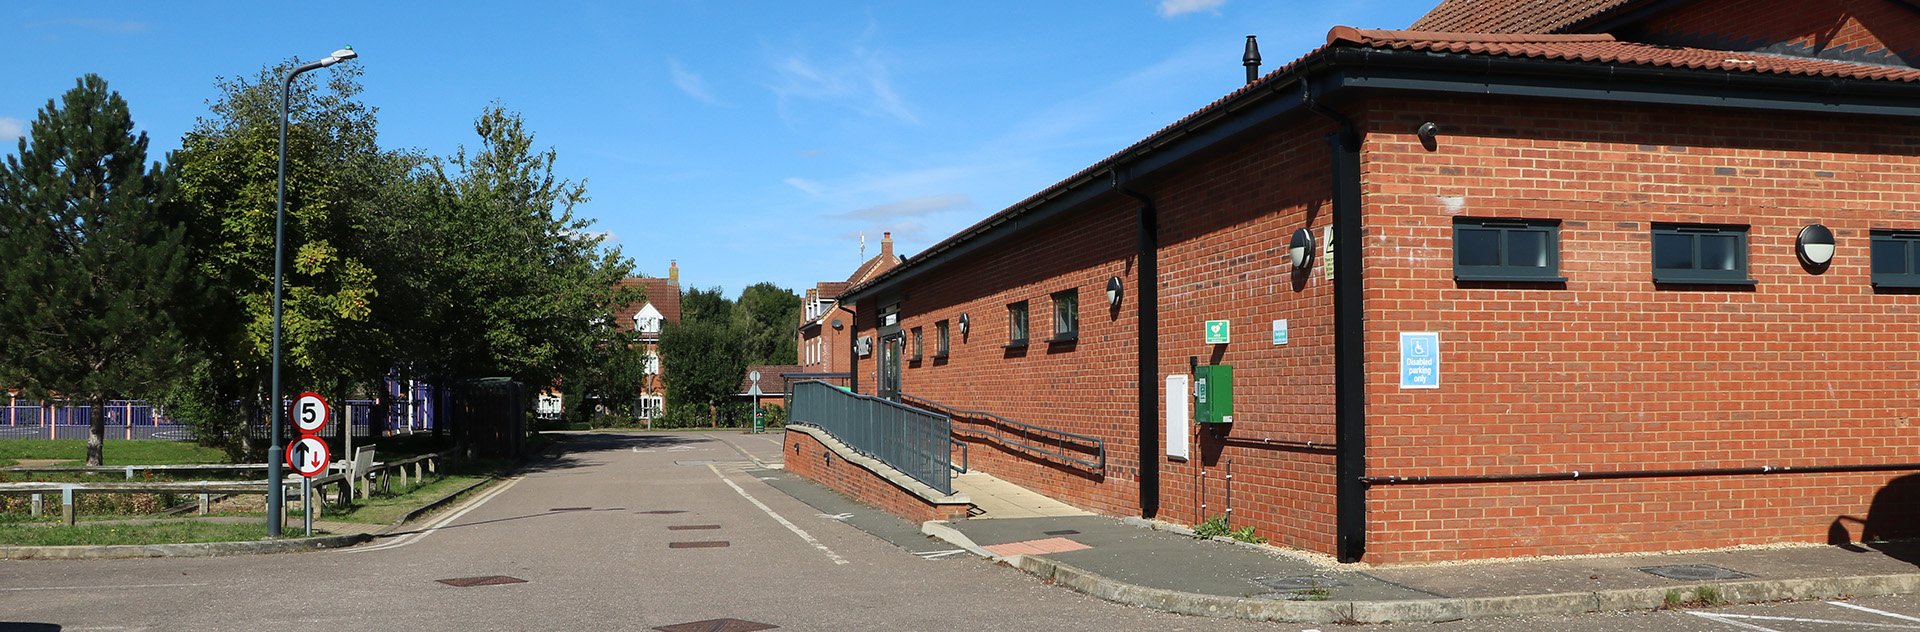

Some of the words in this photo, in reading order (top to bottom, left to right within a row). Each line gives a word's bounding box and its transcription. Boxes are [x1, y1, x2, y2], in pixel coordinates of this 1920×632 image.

[1406, 357, 1432, 366] Disabled
[1408, 366, 1431, 375] parking
[1413, 375, 1427, 384] only
[302, 402, 316, 424] 5
